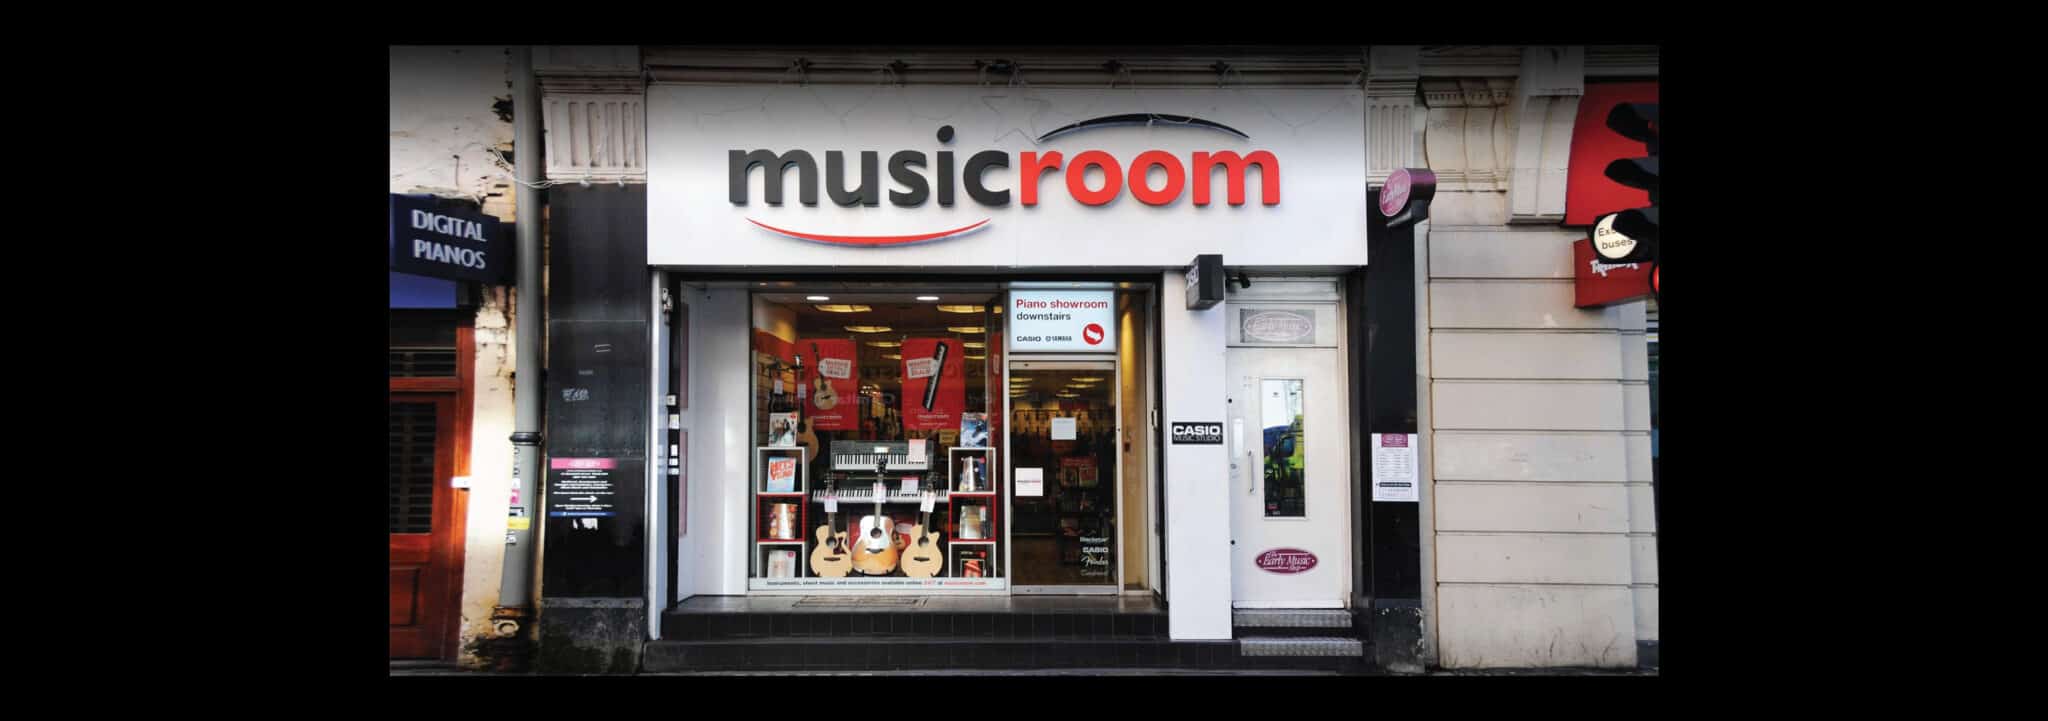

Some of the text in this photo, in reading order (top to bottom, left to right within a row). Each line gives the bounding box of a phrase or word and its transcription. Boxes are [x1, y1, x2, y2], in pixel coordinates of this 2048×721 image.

[727, 124, 1281, 208] musicroom
[412, 209, 487, 242] DIGITAL
[1602, 239, 1633, 250] buses
[414, 239, 486, 269] PIANOS
[1016, 298, 1108, 309] Piano showroom
[1016, 311, 1071, 321] downstairs
[1173, 425, 1221, 436] CASIO
